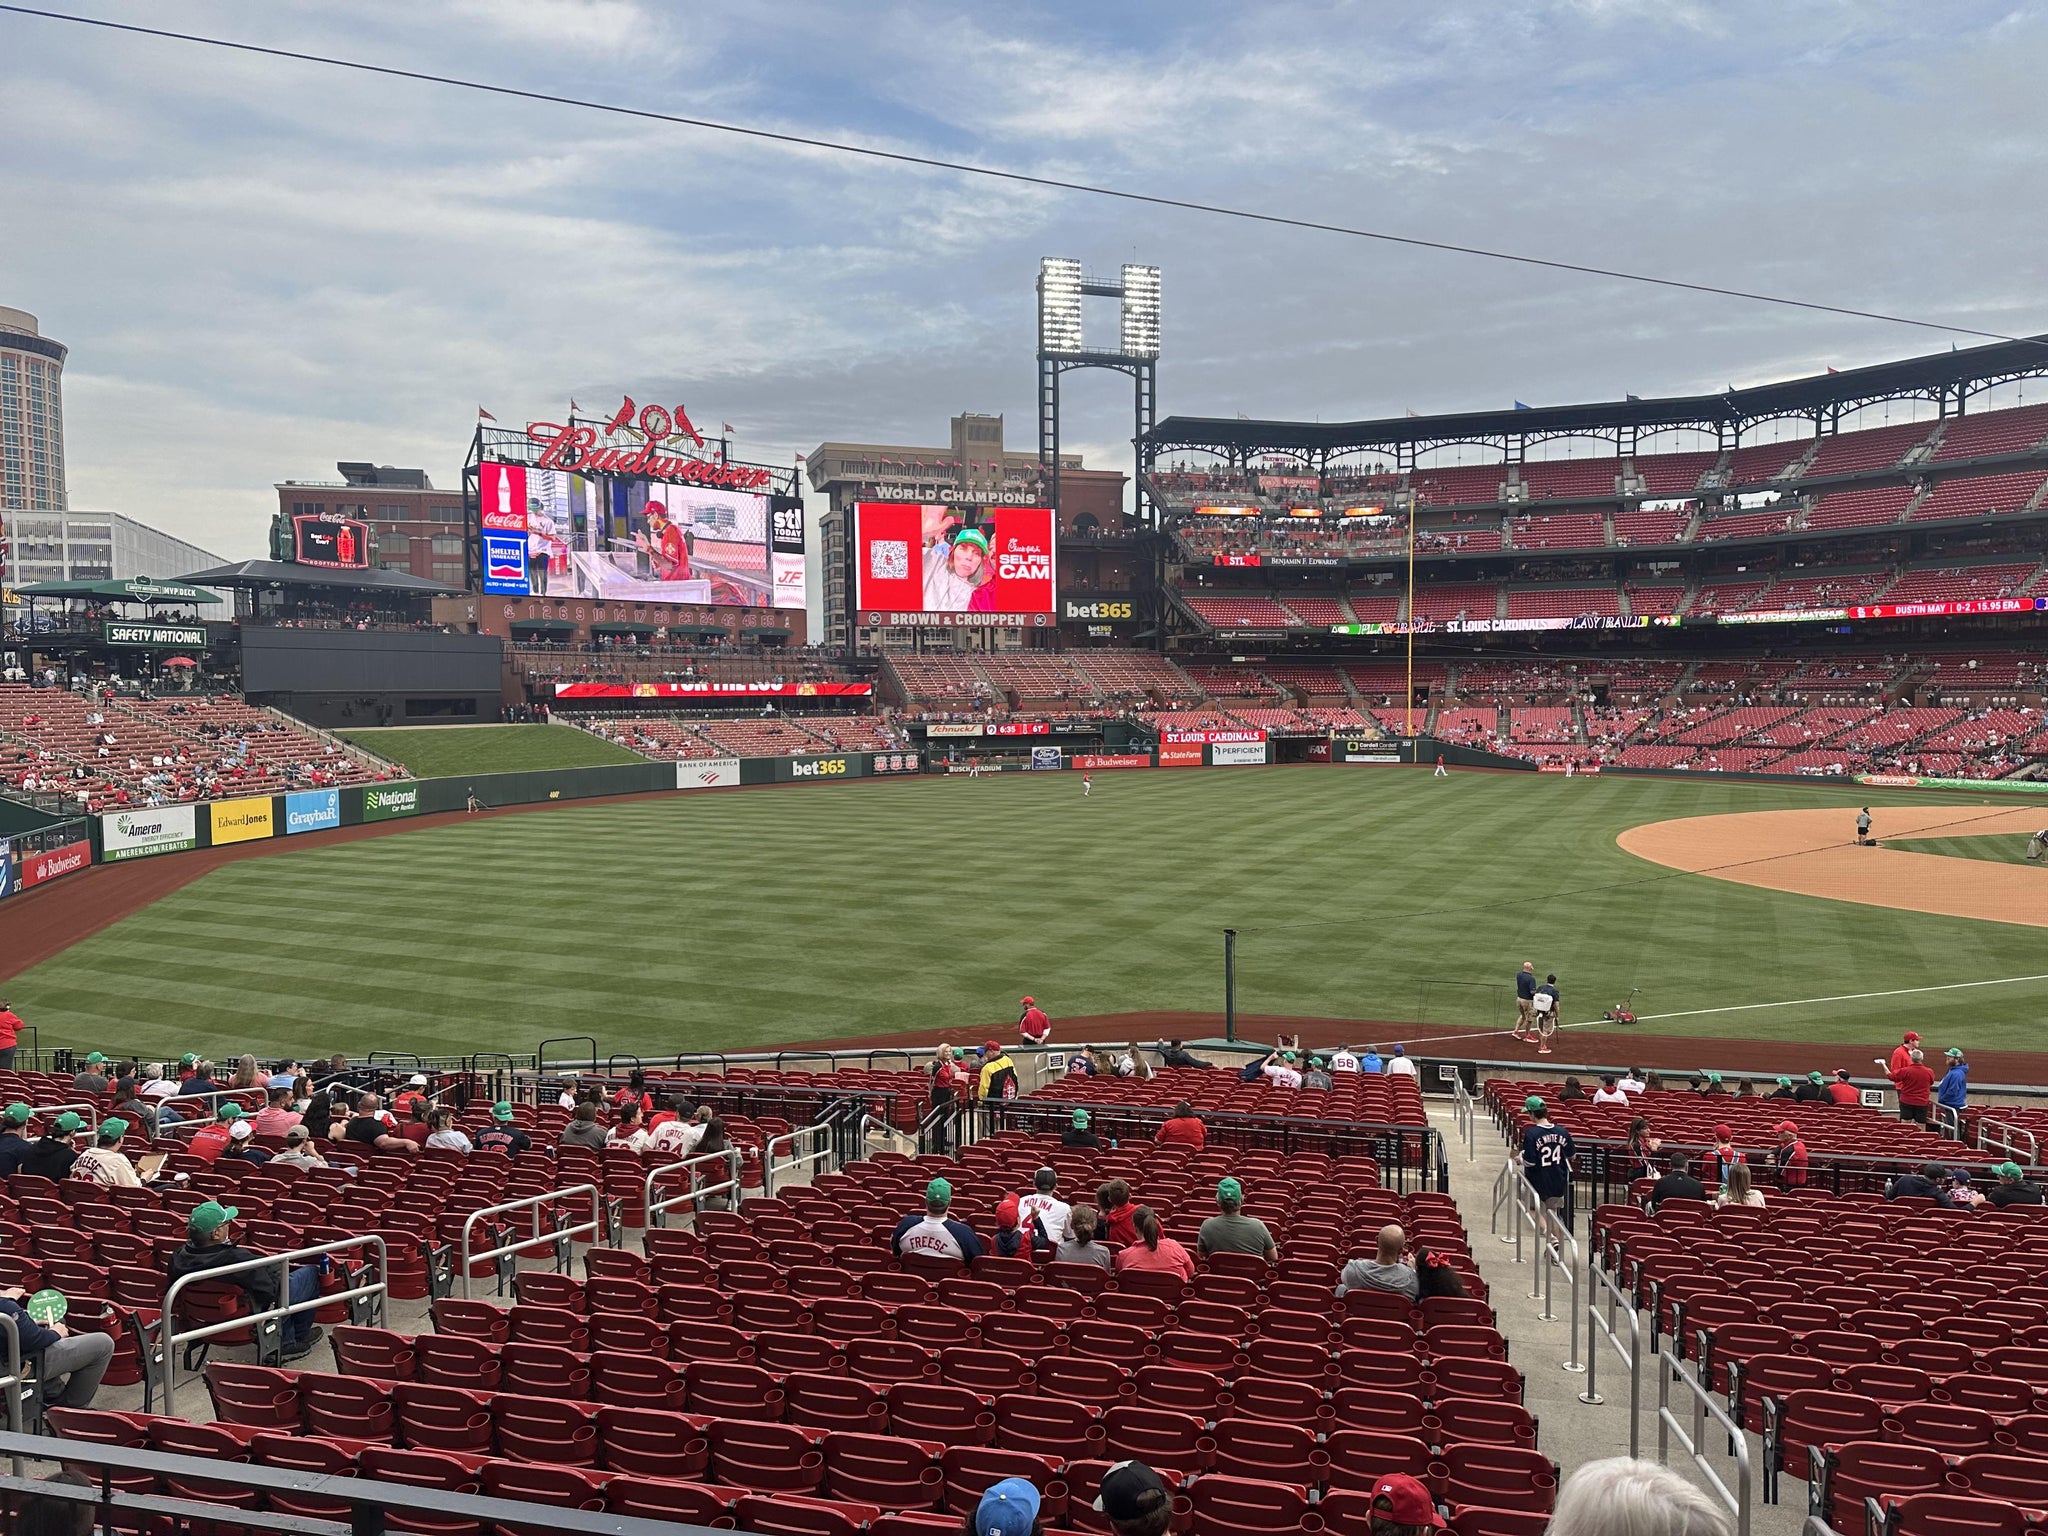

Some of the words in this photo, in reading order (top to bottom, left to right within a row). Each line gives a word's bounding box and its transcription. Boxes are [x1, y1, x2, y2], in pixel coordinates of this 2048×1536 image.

[527, 421, 771, 488] Budweiser
[875, 486, 936, 500] WORLD
[940, 489, 1036, 505] CHAMPIONS
[485, 512, 524, 528] Coca-Cola
[774, 508, 802, 530] stl
[774, 528, 802, 538] TODAY
[490, 547, 520, 556] SHELTER
[1000, 554, 1049, 565] SELFIE
[1229, 557, 1245, 566] STL
[1271, 557, 1301, 566] BENJAMIN
[1308, 558, 1337, 566] EDWARDS
[1000, 565, 1050, 580] CAM
[164, 587, 177, 595] MVP
[179, 588, 197, 597] DECK
[542, 605, 552, 620] 2
[559, 606, 568, 620] 6
[576, 606, 585, 620] 9
[593, 607, 605, 621] 10
[613, 608, 626, 622] 14
[634, 609, 646, 623] 17
[653, 610, 670, 624] 20
[679, 611, 693, 625] 23
[700, 612, 714, 625] 24
[1066, 601, 1132, 618] bet365
[1896, 603, 1926, 615] DUSTIN
[1927, 605, 1946, 613] MAY
[1977, 601, 2001, 611] 15.95
[2002, 601, 2021, 610] ERA
[890, 613, 940, 625] BROWN
[955, 613, 1024, 626] CROUPPEN
[1721, 613, 1756, 623] TODAY'S
[1758, 611, 1798, 621] PITCHING
[1801, 609, 1845, 619] MATCHUP
[1447, 622, 1461, 633] ST.
[1462, 620, 1491, 632] LOUIS
[1492, 619, 1549, 631] CARDINALS
[112, 628, 151, 641] SAFETY
[153, 630, 202, 644] NATIONAL
[931, 725, 977, 733] Schnucks
[1000, 726, 1016, 734] 6:35
[1180, 732, 1206, 743] LOUIS
[1208, 732, 1260, 742] CARDINALS
[1222, 747, 1264, 755] PERFICIENT
[792, 760, 846, 776] bet365
[1097, 758, 1138, 766] Budweiser
[379, 790, 416, 806] National
[218, 815, 246, 828] Edward
[245, 814, 268, 826] Jones
[289, 808, 336, 826] GraybaR
[128, 823, 162, 837] Ameren
[141, 835, 159, 843] ENERGY
[159, 832, 184, 841] EFFICIENCY
[115, 840, 188, 859] AMEREN.COM/REBATES
[48, 853, 81, 876] Budweiser
[1337, 1058, 1354, 1068] 58
[665, 1129, 684, 1138] ORTIZ
[1541, 1144, 1561, 1167] 24
[74, 1155, 101, 1173] FREESE
[1023, 1197, 1053, 1212] MOLINA
[910, 1236, 948, 1254] FREESE
